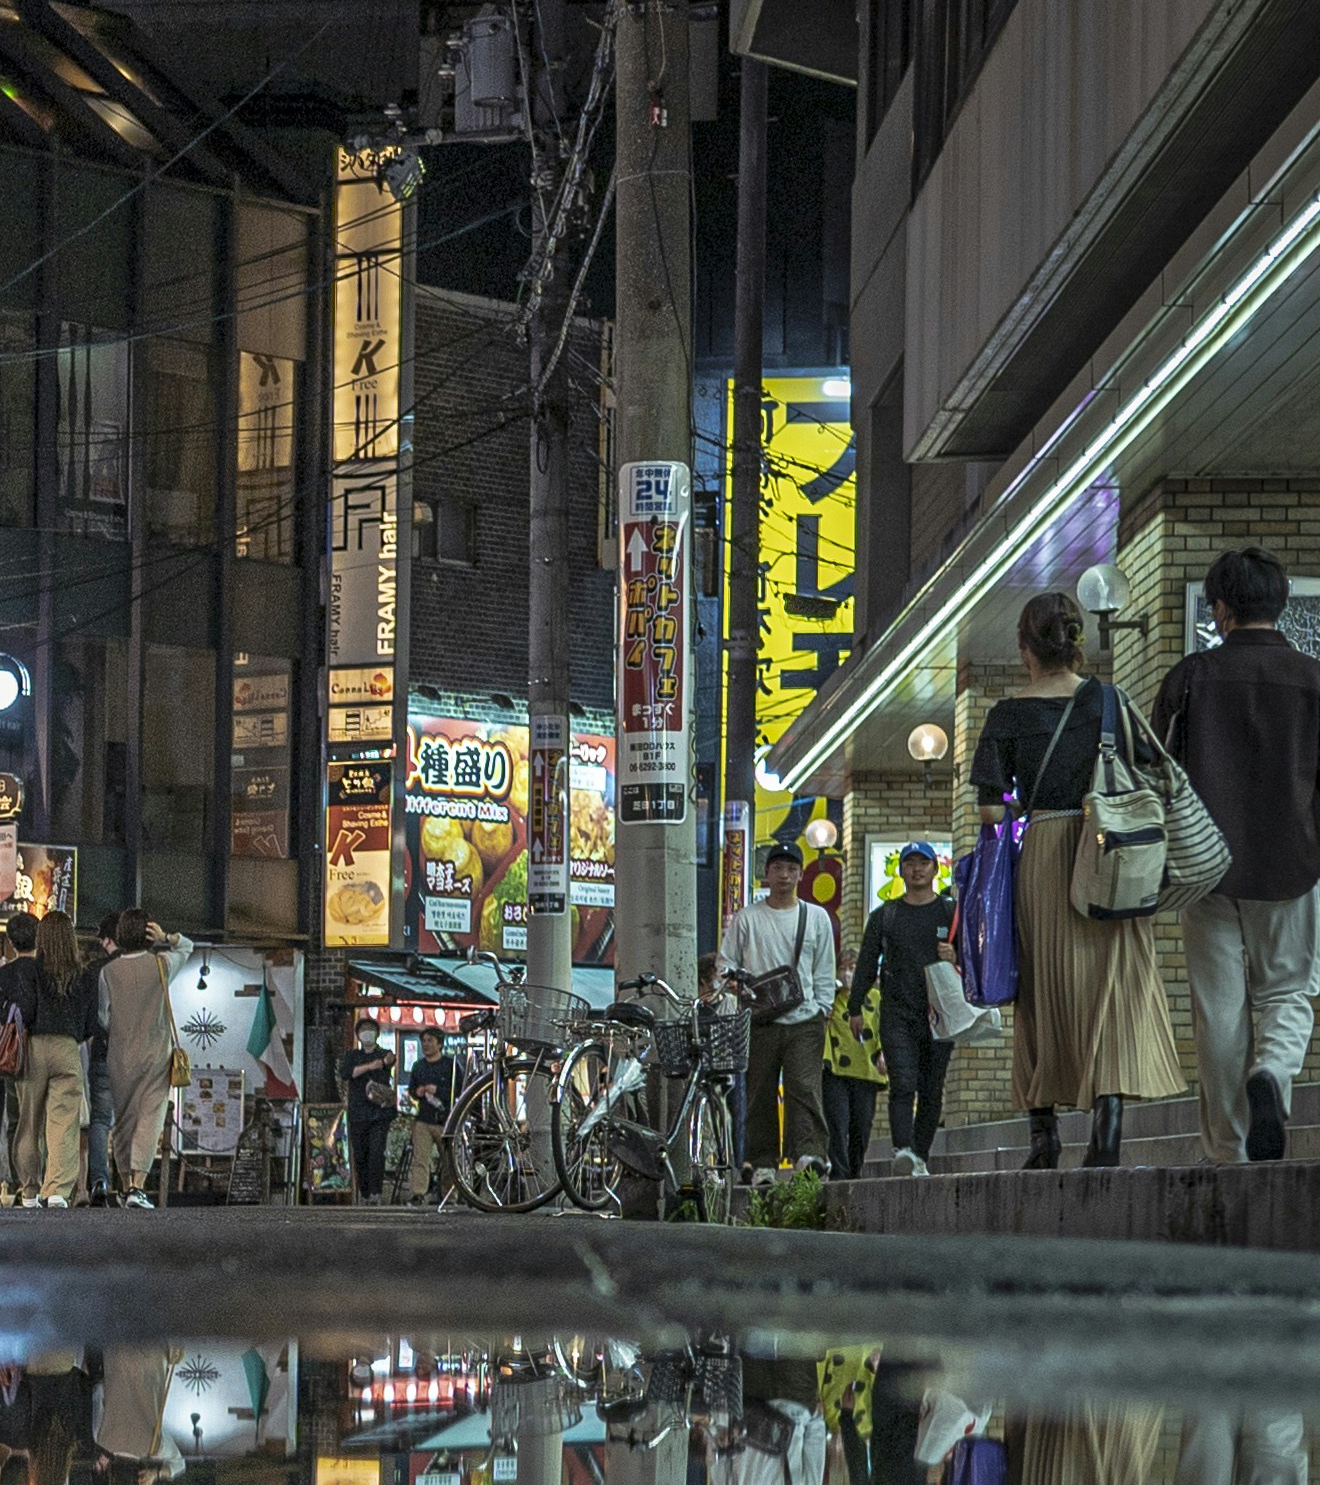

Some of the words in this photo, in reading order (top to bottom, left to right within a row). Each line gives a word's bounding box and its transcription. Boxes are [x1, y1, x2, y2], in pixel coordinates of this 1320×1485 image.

[351, 377, 379, 392] Free
[635, 480, 672, 502] 24
[378, 510, 399, 560] hair
[331, 573, 343, 629] FRAMY
[376, 562, 398, 655] FRAMY
[652, 524, 680, 701] ネットカフェ
[627, 576, 658, 670] ポパイ
[632, 703, 676, 717] まっすぐ
[329, 868, 356, 881] Free
[426, 877, 472, 894] マヨネーズ
